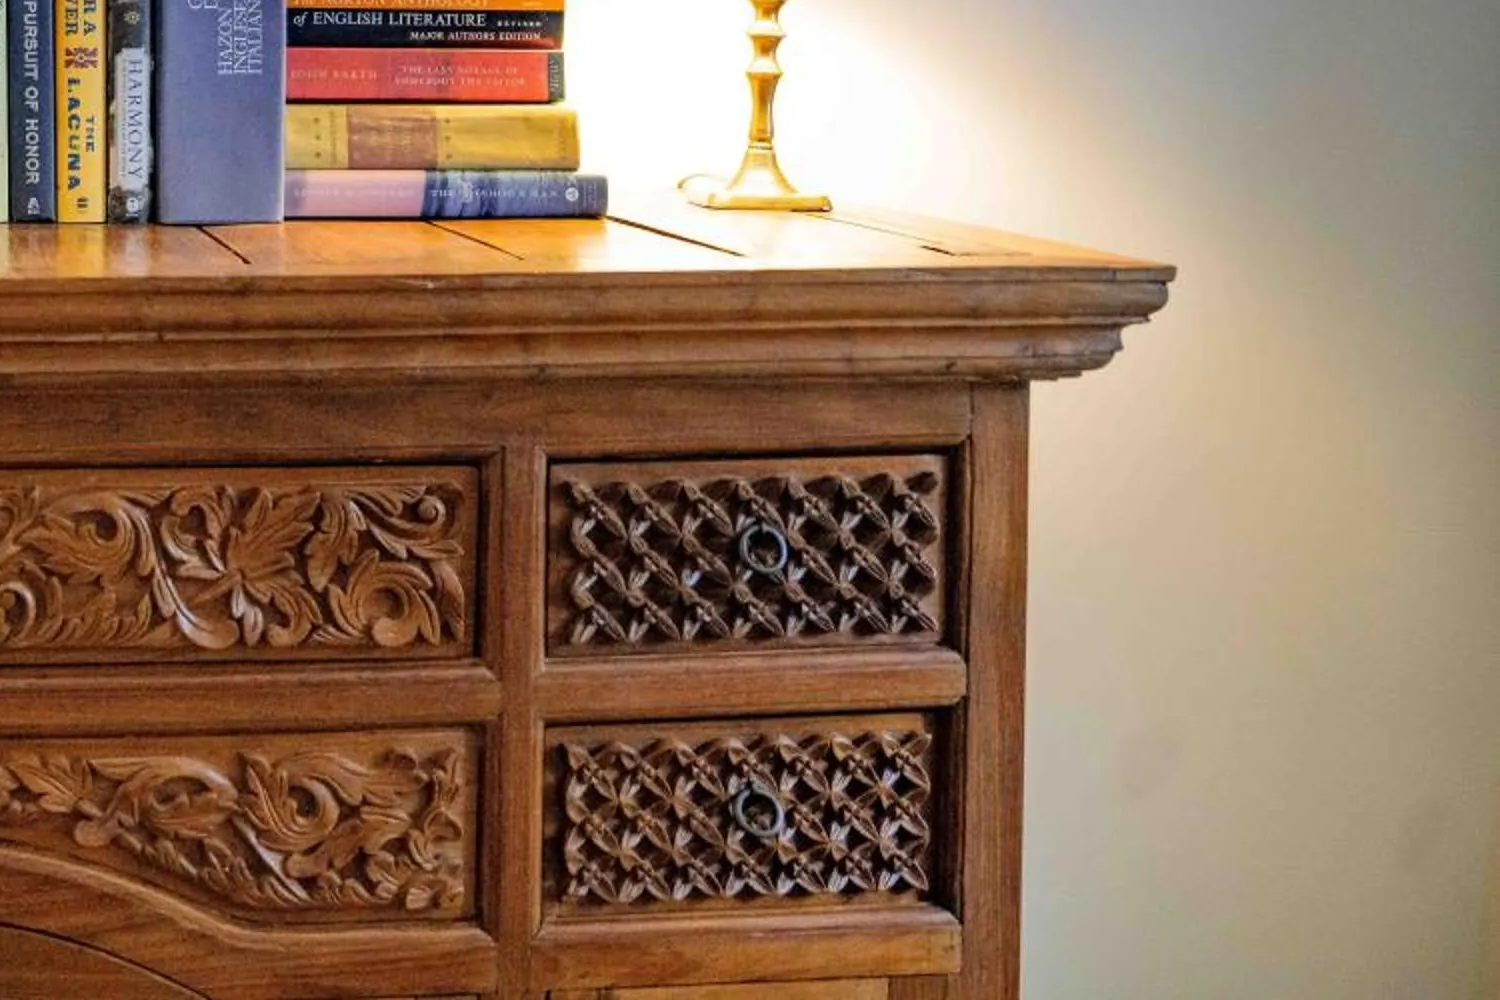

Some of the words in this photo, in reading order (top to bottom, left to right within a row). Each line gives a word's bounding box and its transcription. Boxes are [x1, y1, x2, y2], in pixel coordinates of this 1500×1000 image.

[24, 0, 38, 79] PURSUIT
[218, 8, 233, 75] HAZON
[233, 1, 247, 74] INGLESE
[293, 12, 307, 26] of
[313, 12, 383, 25] ENGLISH
[389, 12, 487, 27] LITERATURE
[410, 31, 444, 41] MAJOR
[449, 31, 495, 41] AUTHORS
[500, 32, 541, 41] EDITION
[25, 85, 39, 109] OF
[127, 59, 143, 179] HARMONY
[25, 119, 40, 184] HONOR
[67, 76, 81, 190] LACUNA
[85, 113, 95, 152] THE
